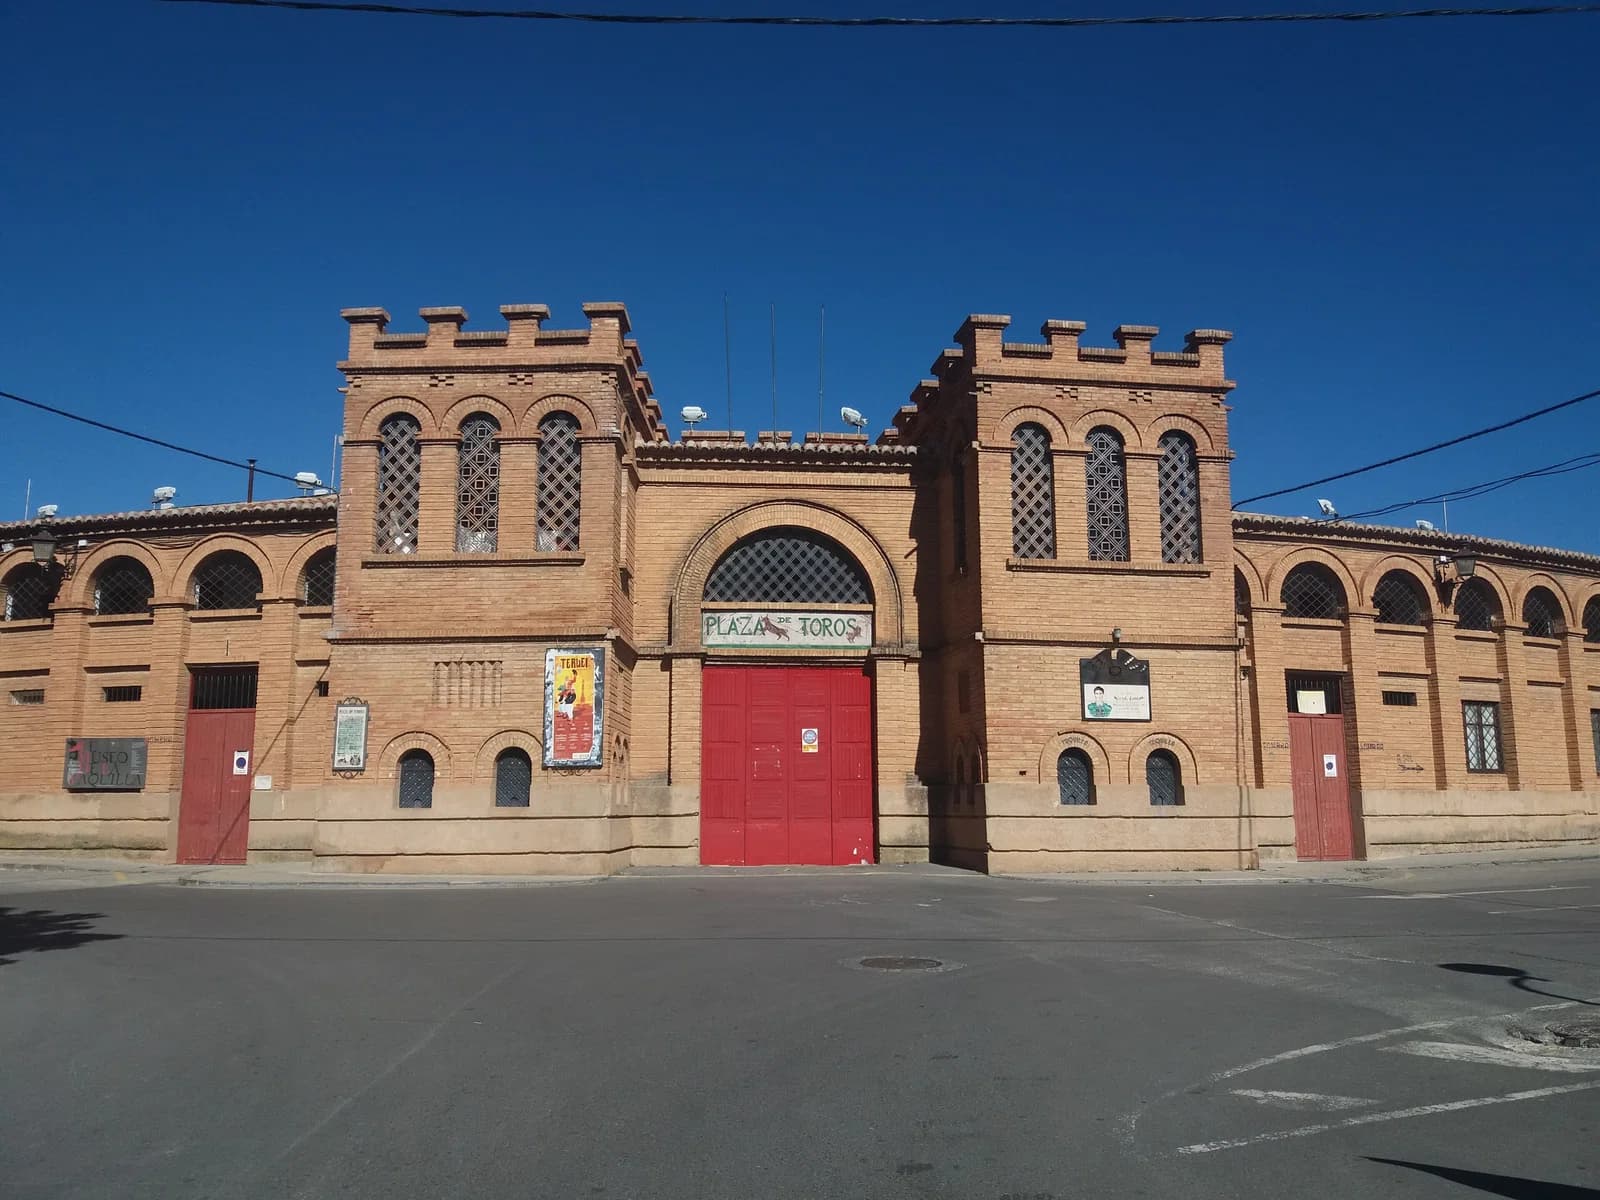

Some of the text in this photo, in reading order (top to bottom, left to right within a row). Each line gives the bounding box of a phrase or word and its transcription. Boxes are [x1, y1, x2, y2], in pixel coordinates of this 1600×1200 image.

[706, 615, 857, 638] PLAZA DE TOROS
